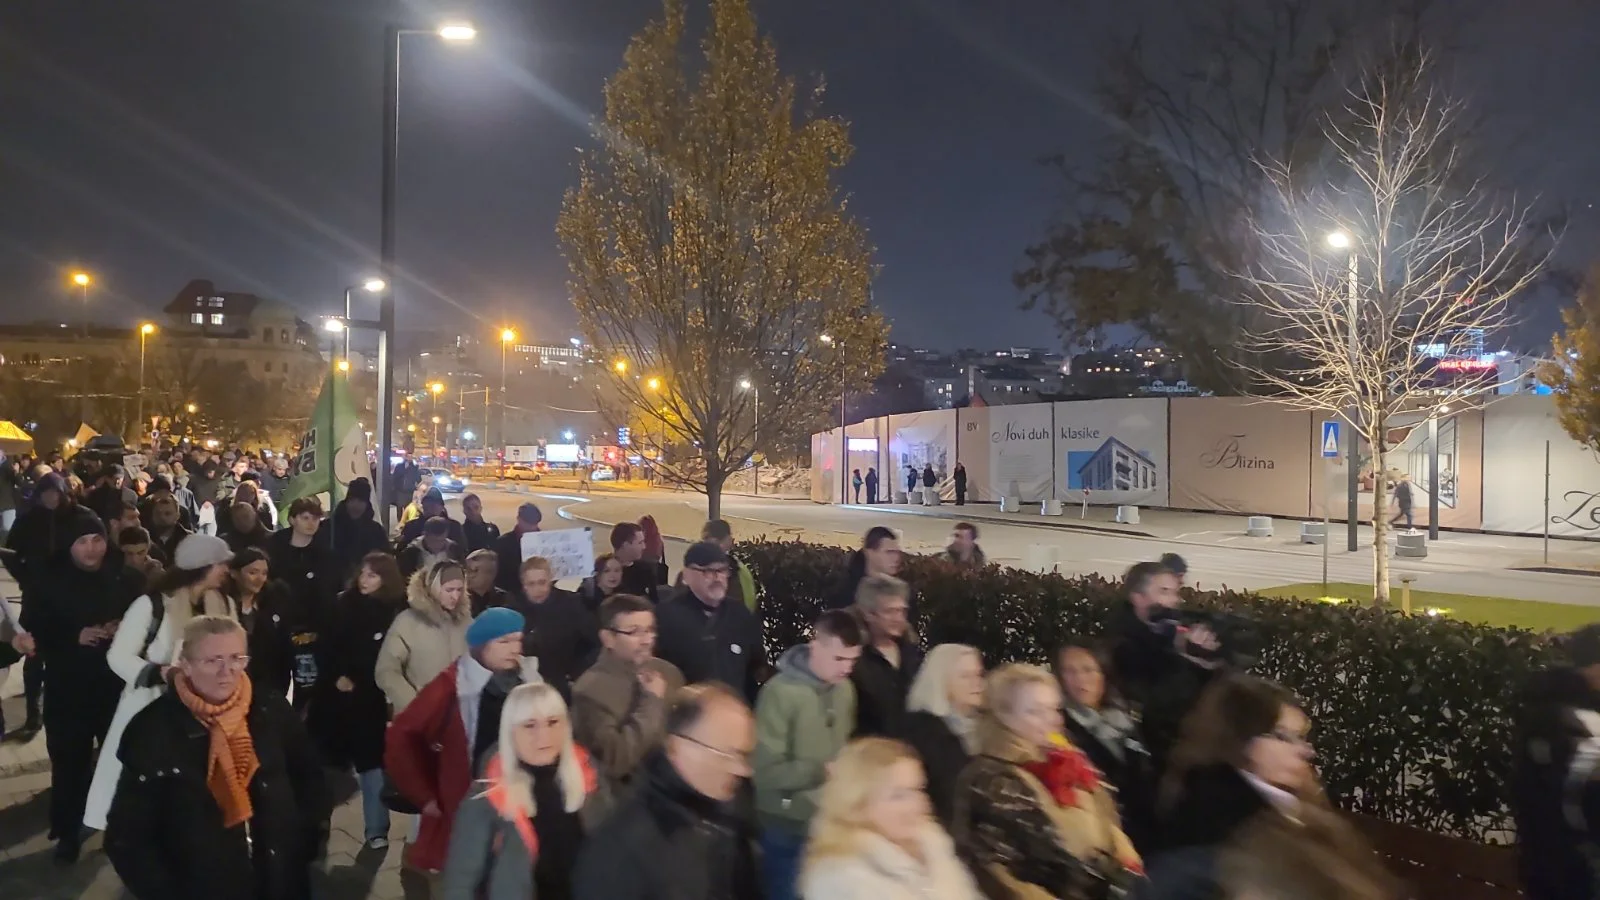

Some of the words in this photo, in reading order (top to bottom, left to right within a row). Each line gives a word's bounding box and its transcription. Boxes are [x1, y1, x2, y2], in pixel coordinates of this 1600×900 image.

[991, 420, 1025, 443] Novi
[1028, 428, 1050, 440] duh
[1060, 426, 1100, 439] klasike
[1199, 434, 1275, 469] Blizina
